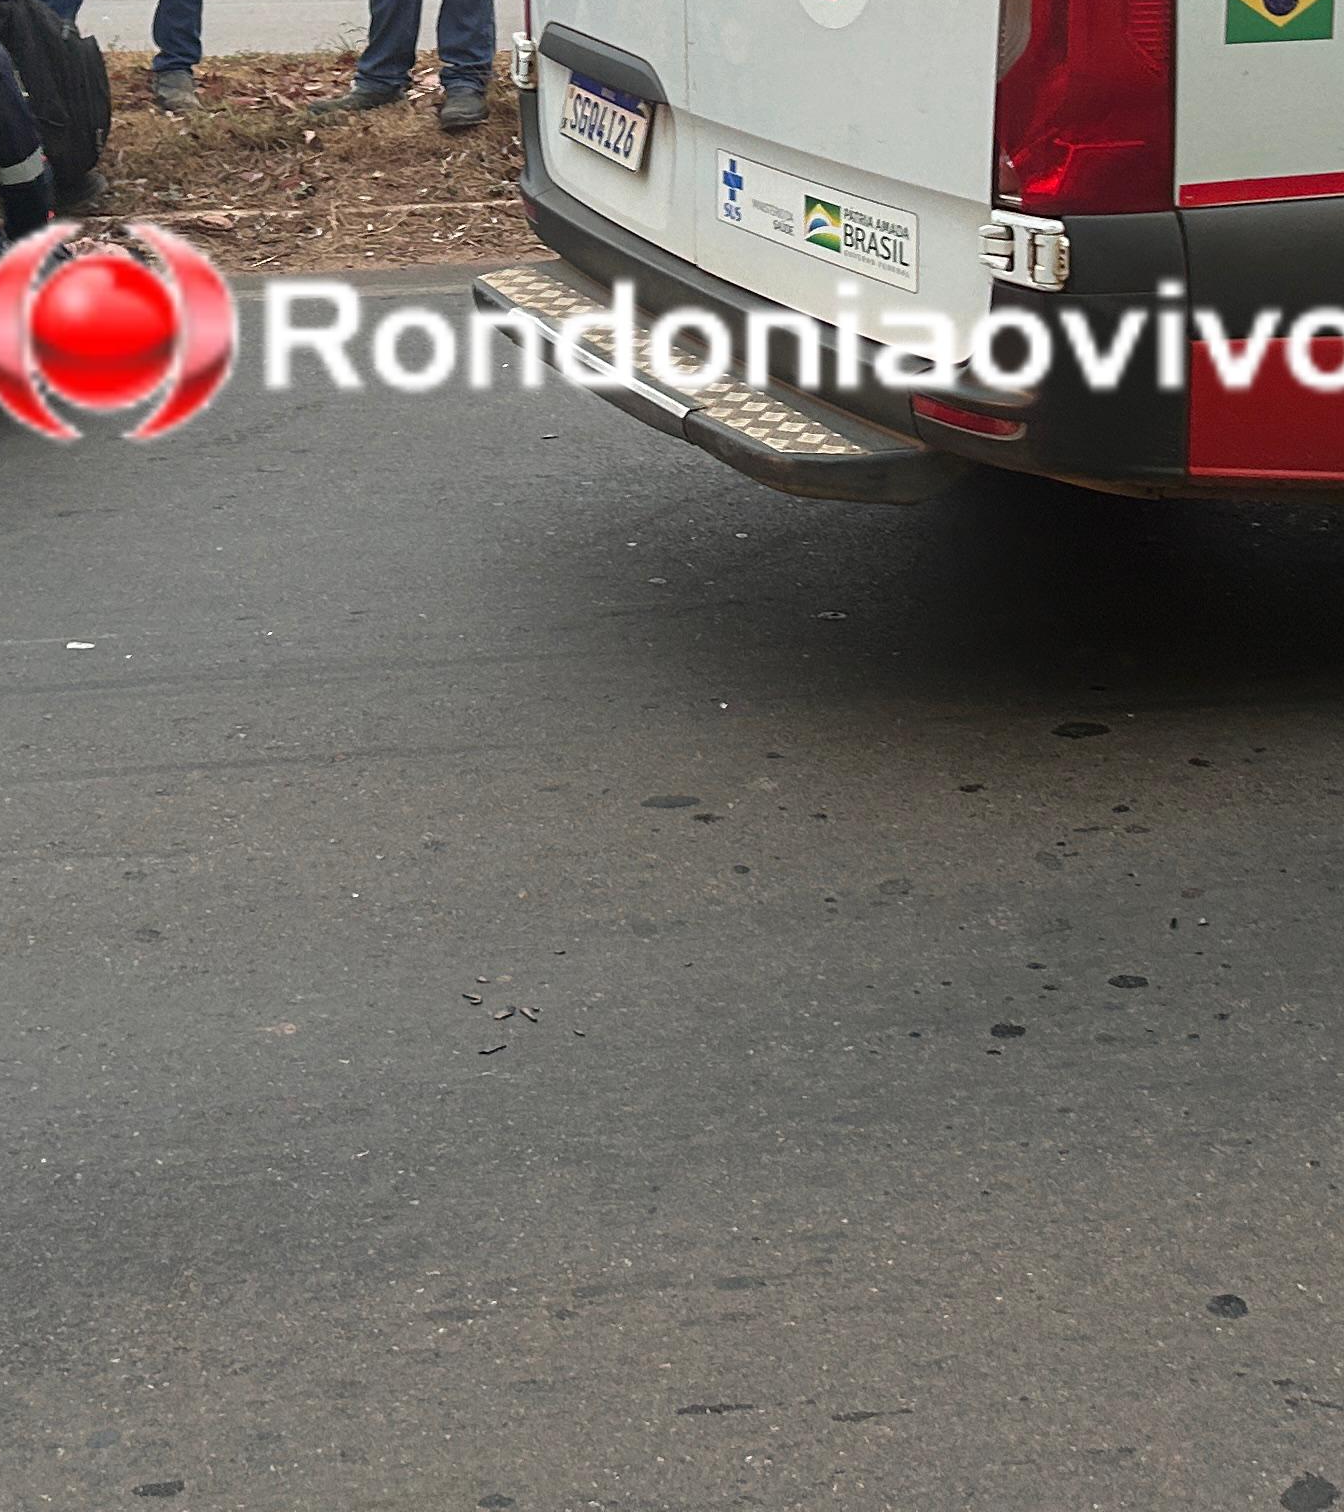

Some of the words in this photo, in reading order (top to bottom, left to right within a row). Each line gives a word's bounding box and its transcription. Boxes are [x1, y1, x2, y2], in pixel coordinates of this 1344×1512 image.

[723, 202, 742, 222] SUS
[843, 206, 874, 228] PÁTRIA
[875, 218, 910, 240] AMADA
[843, 223, 910, 267] BRASIL
